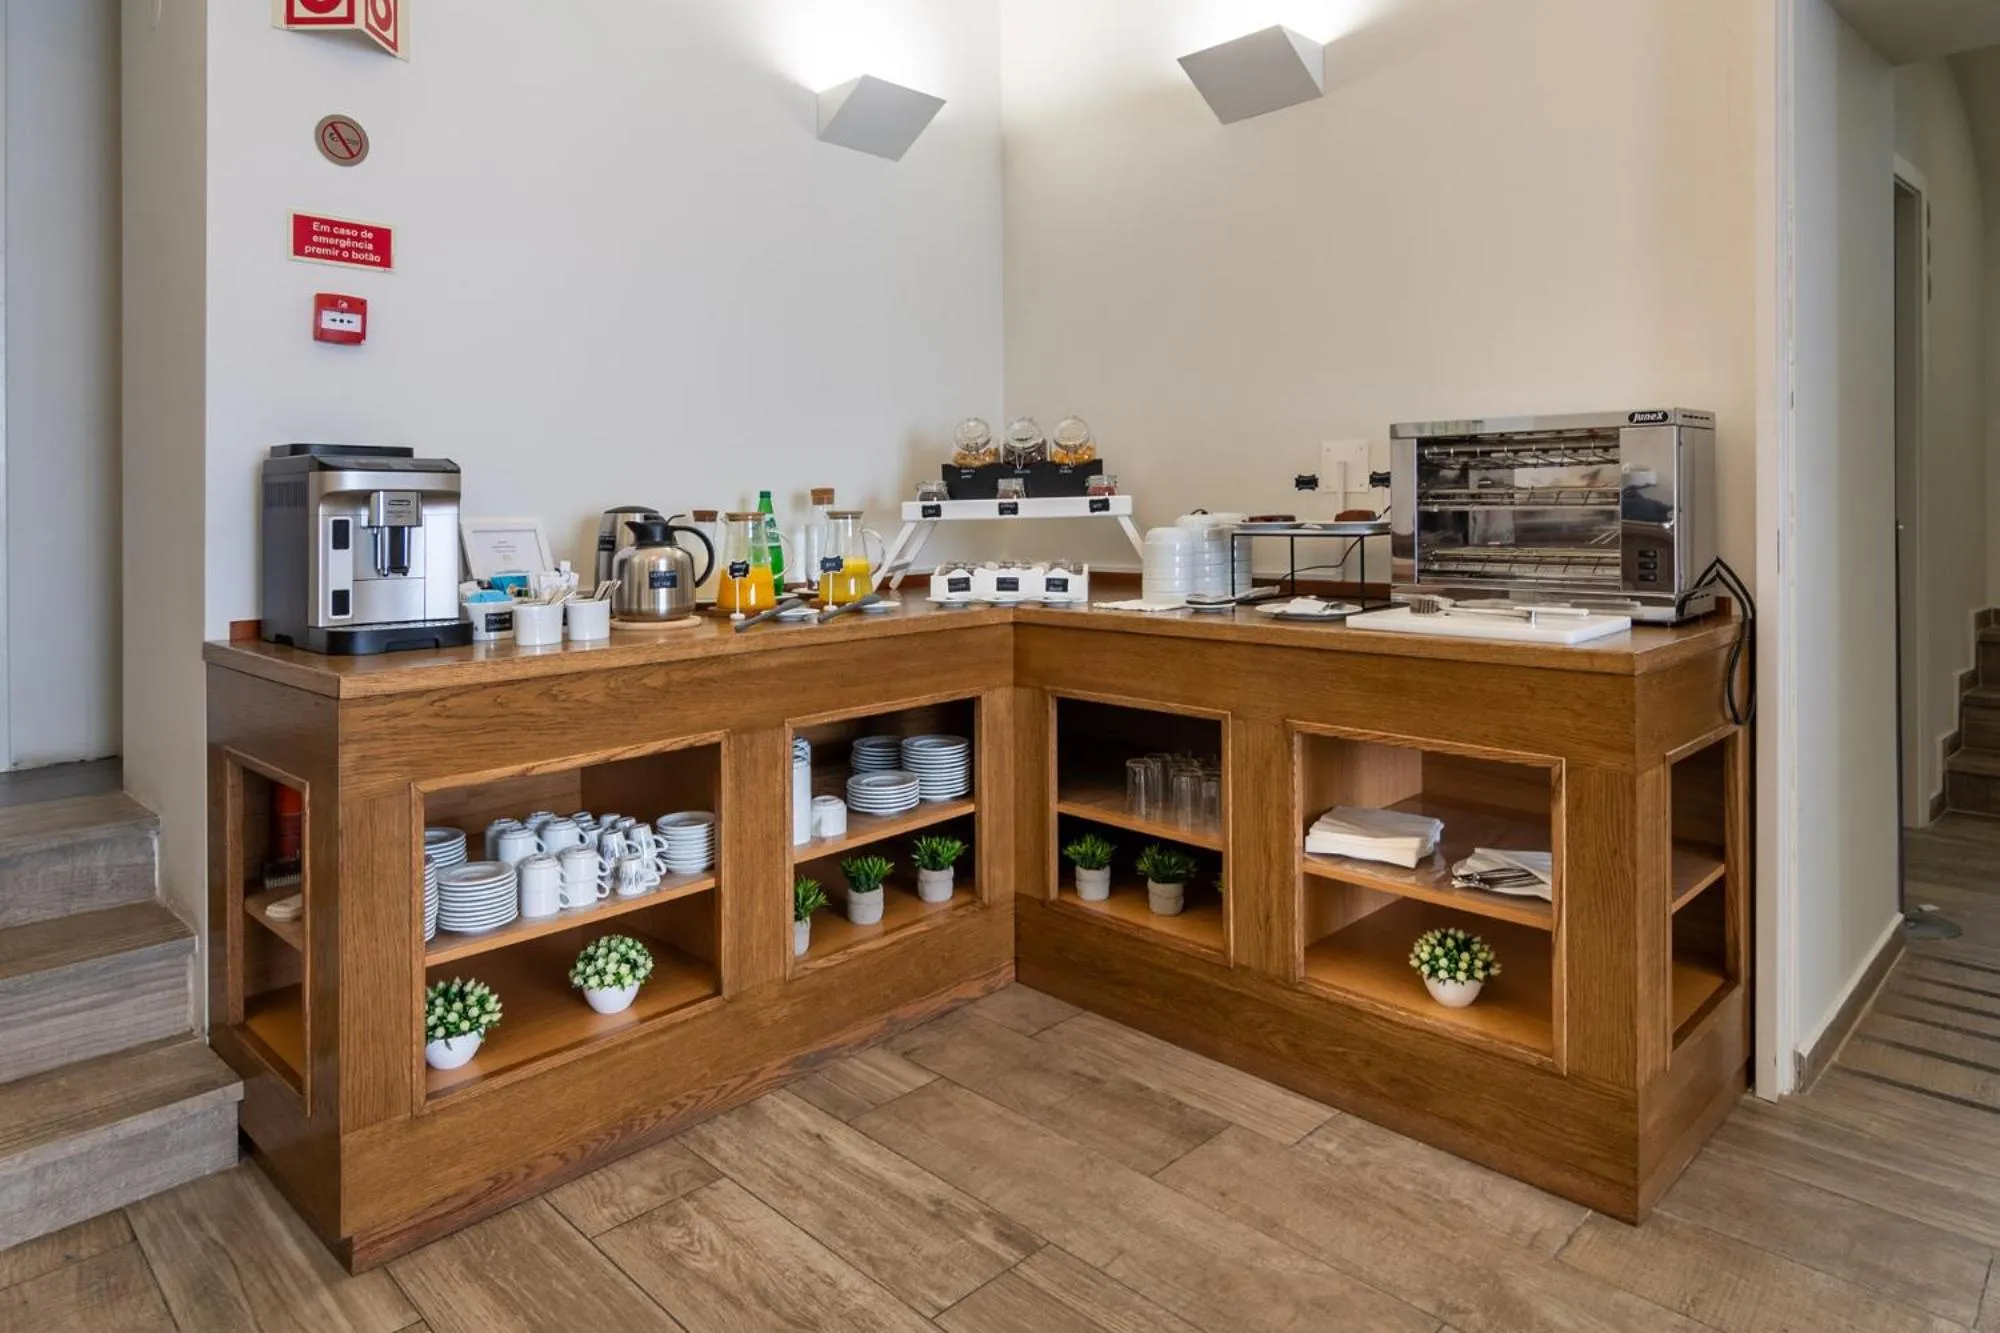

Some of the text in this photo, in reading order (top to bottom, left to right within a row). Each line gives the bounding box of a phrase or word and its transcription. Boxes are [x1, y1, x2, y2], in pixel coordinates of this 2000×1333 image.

[312, 222, 374, 239] Em caso de
[312, 235, 374, 250] emergência
[304, 245, 381, 263] premir o botão
